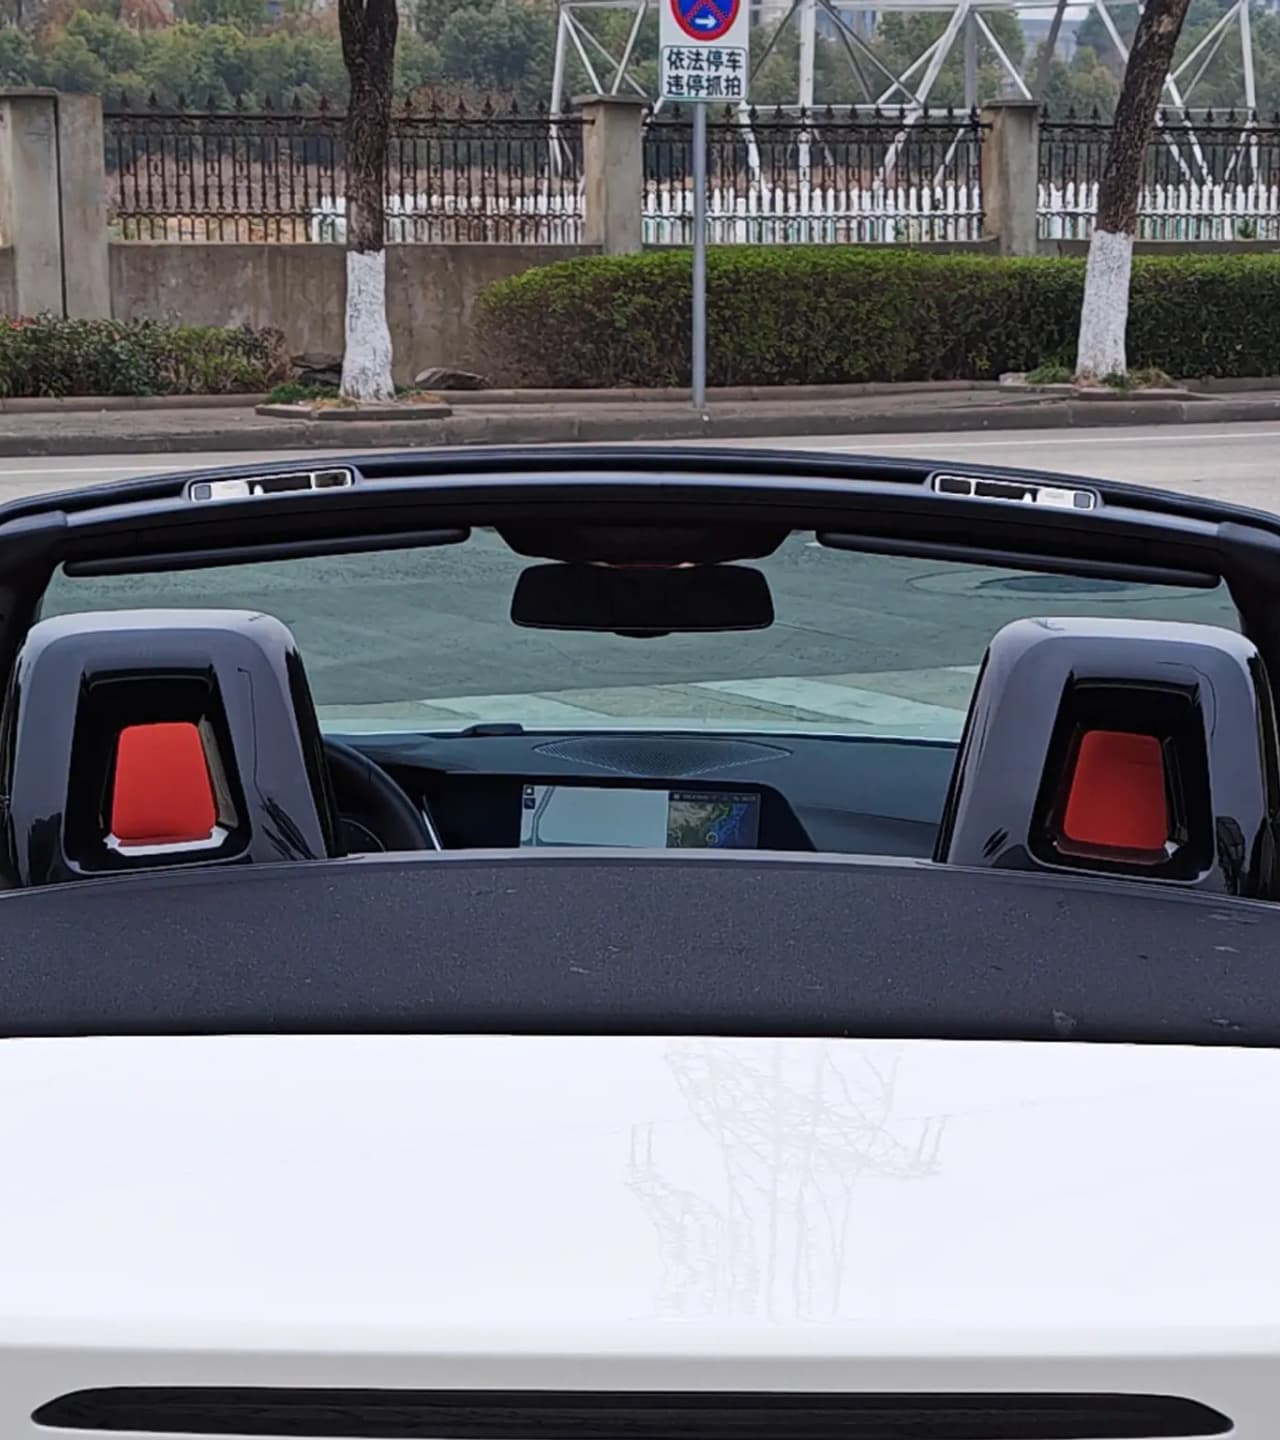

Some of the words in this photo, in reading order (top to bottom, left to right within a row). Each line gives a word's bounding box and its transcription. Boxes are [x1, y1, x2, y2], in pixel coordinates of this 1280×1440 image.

[667, 48, 742, 72] 依法停车
[666, 74, 741, 96] 违停抓拍
